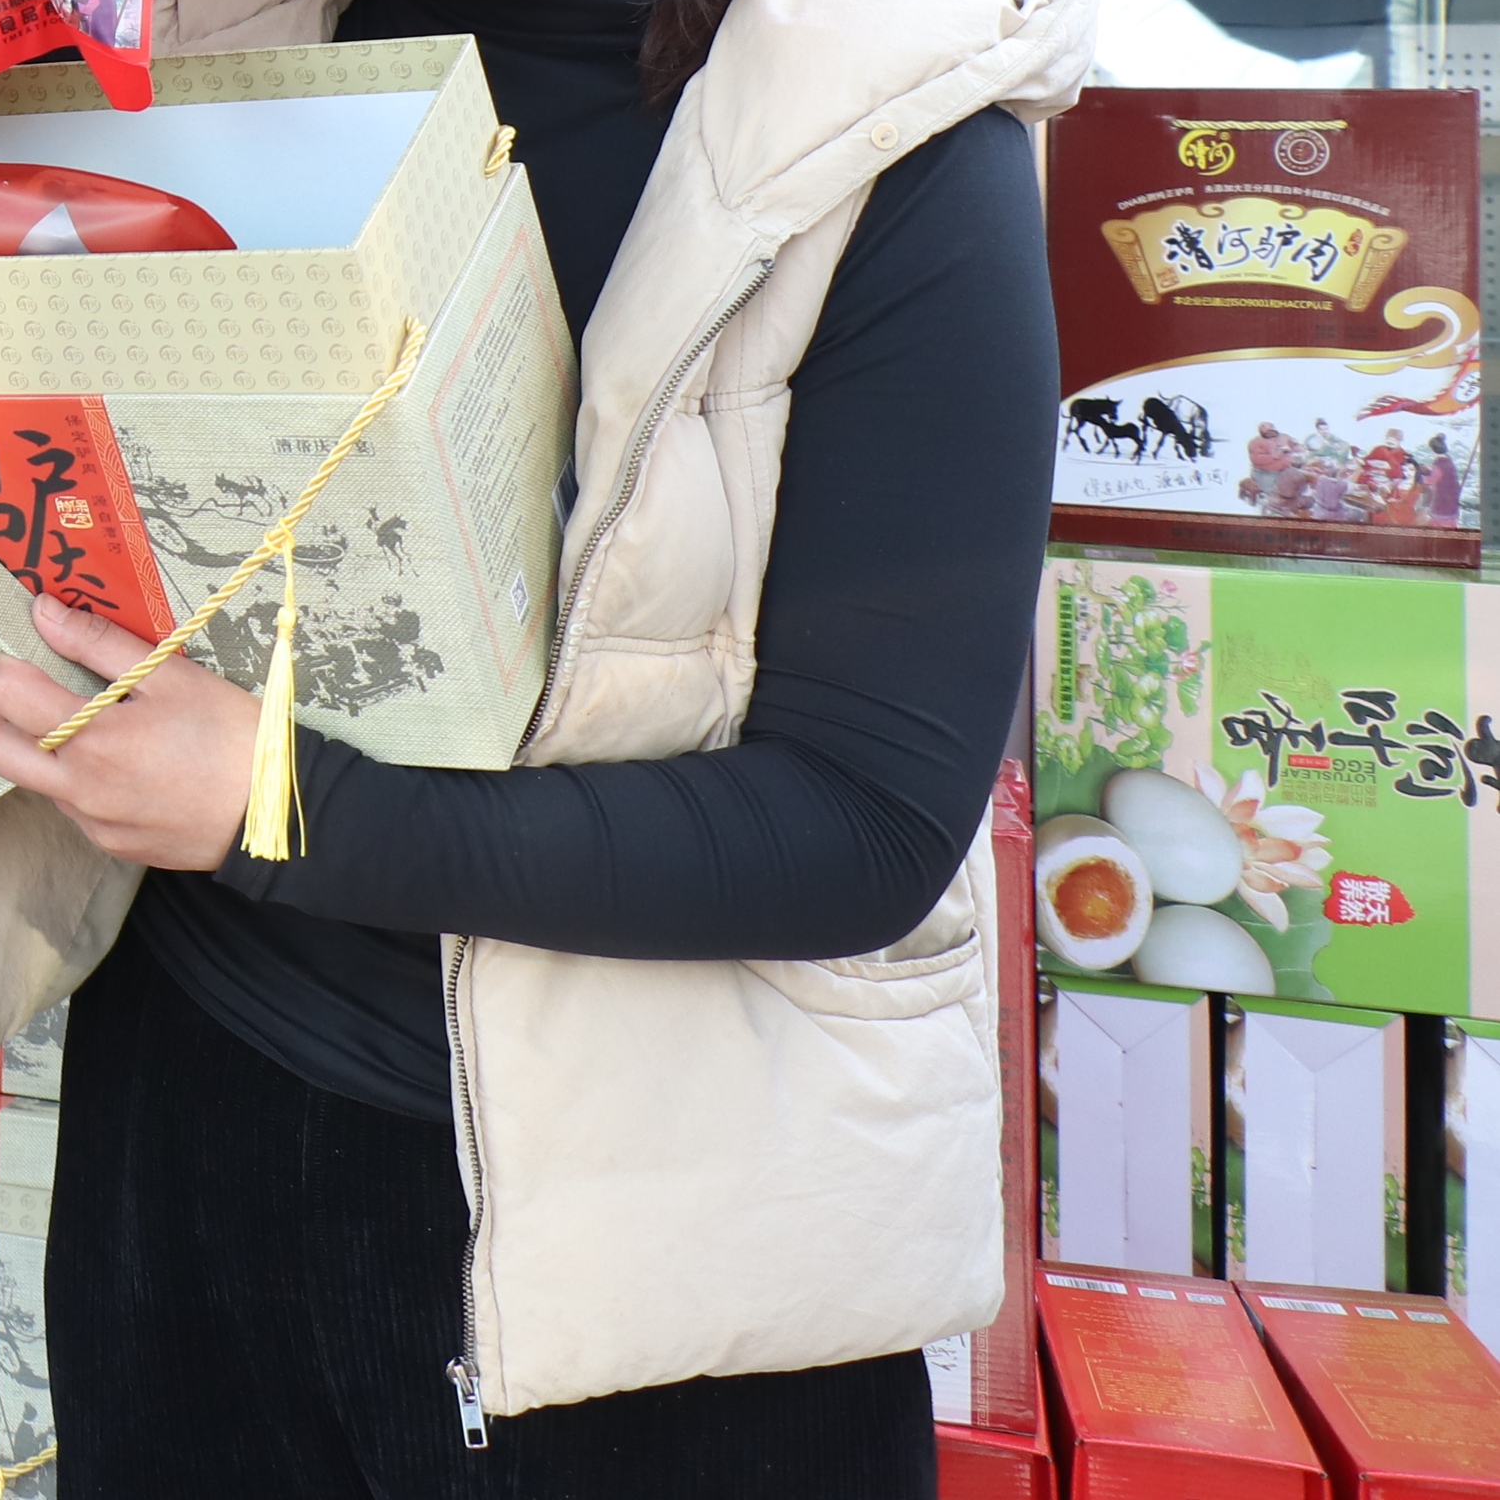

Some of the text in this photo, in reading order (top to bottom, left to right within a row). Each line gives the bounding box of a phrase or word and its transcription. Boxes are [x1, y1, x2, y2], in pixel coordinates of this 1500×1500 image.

[1164, 221, 1339, 282] 漕河驴肉
[1332, 758, 1376, 775] EGG
[1280, 769, 1377, 784] LOTUSLEAF
